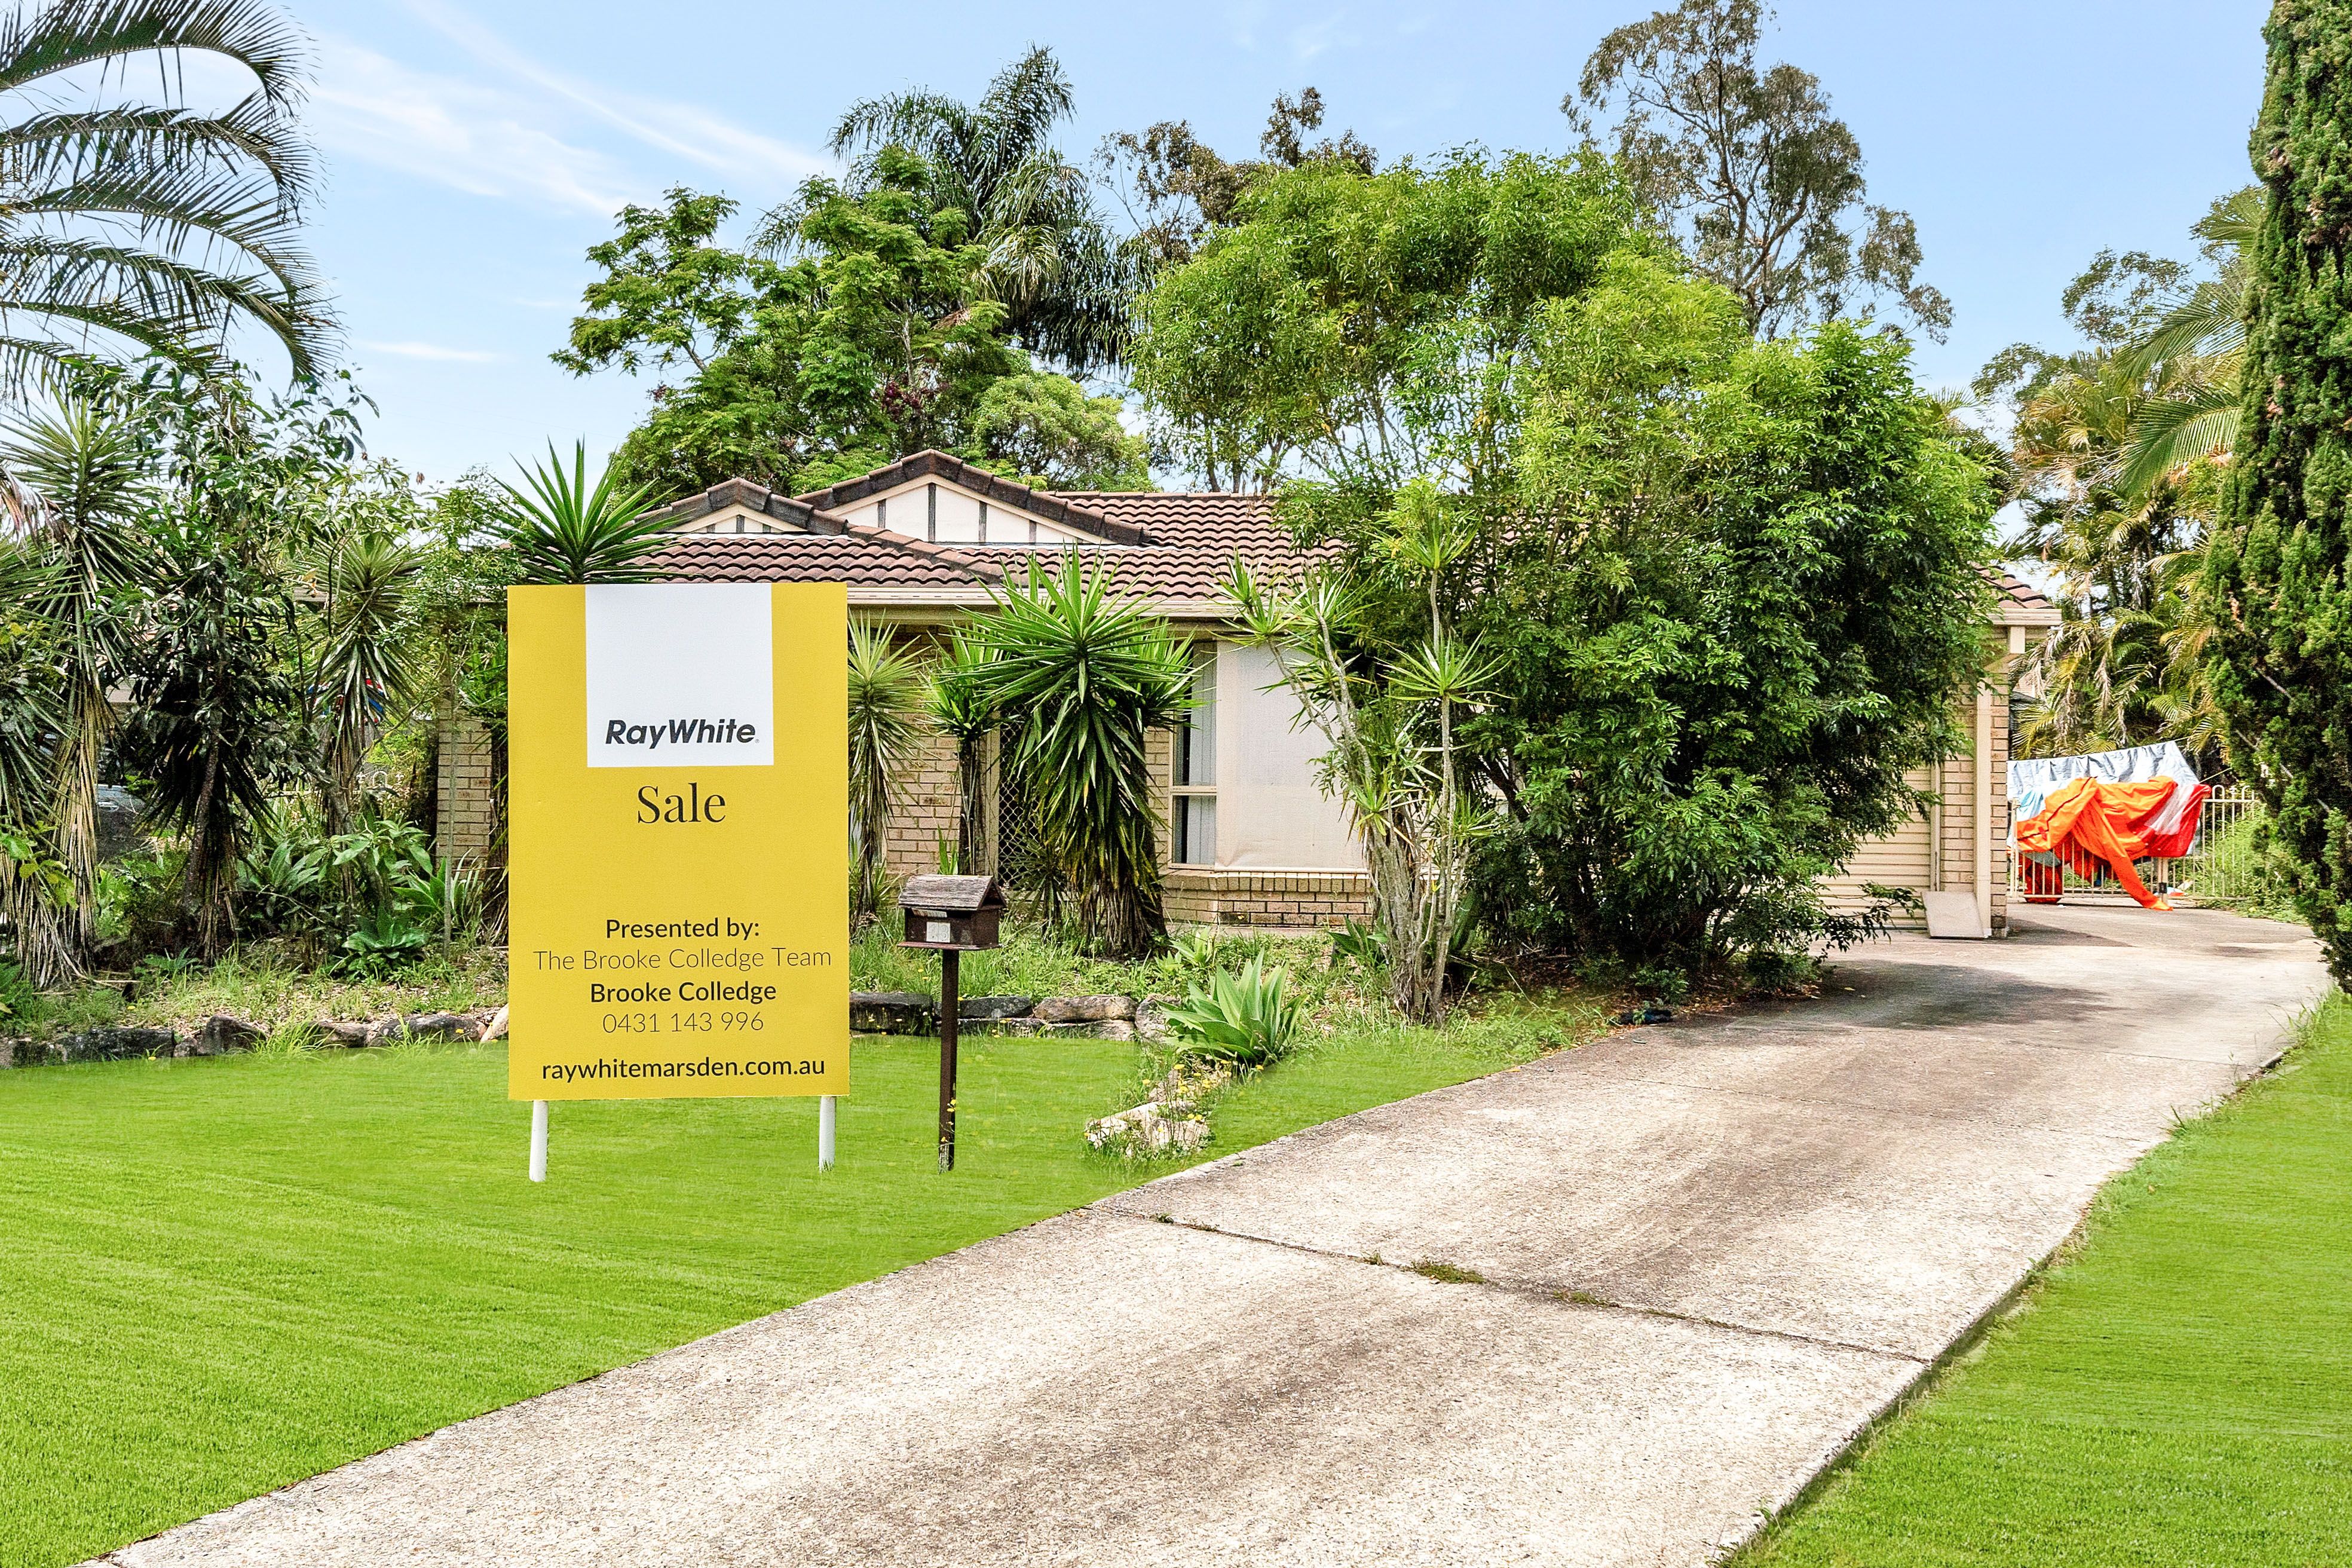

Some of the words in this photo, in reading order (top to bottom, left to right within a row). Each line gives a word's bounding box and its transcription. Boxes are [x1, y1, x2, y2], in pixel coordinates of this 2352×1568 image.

[605, 718, 756, 750] RayWhite
[638, 782, 726, 824] Sale
[607, 917, 719, 939] Presented
[727, 917, 760, 941] by:
[532, 950, 574, 970] The
[584, 949, 661, 970] Brooke
[669, 947, 764, 972] Colledge
[771, 947, 831, 966] Team
[591, 982, 672, 1003] Brooke
[678, 980, 777, 1005] Colledge
[602, 1013, 660, 1033] 0431
[670, 1012, 712, 1032] 143
[721, 1011, 764, 1031] 996
[543, 1056, 825, 1083] raywhitemarsden.com.au
